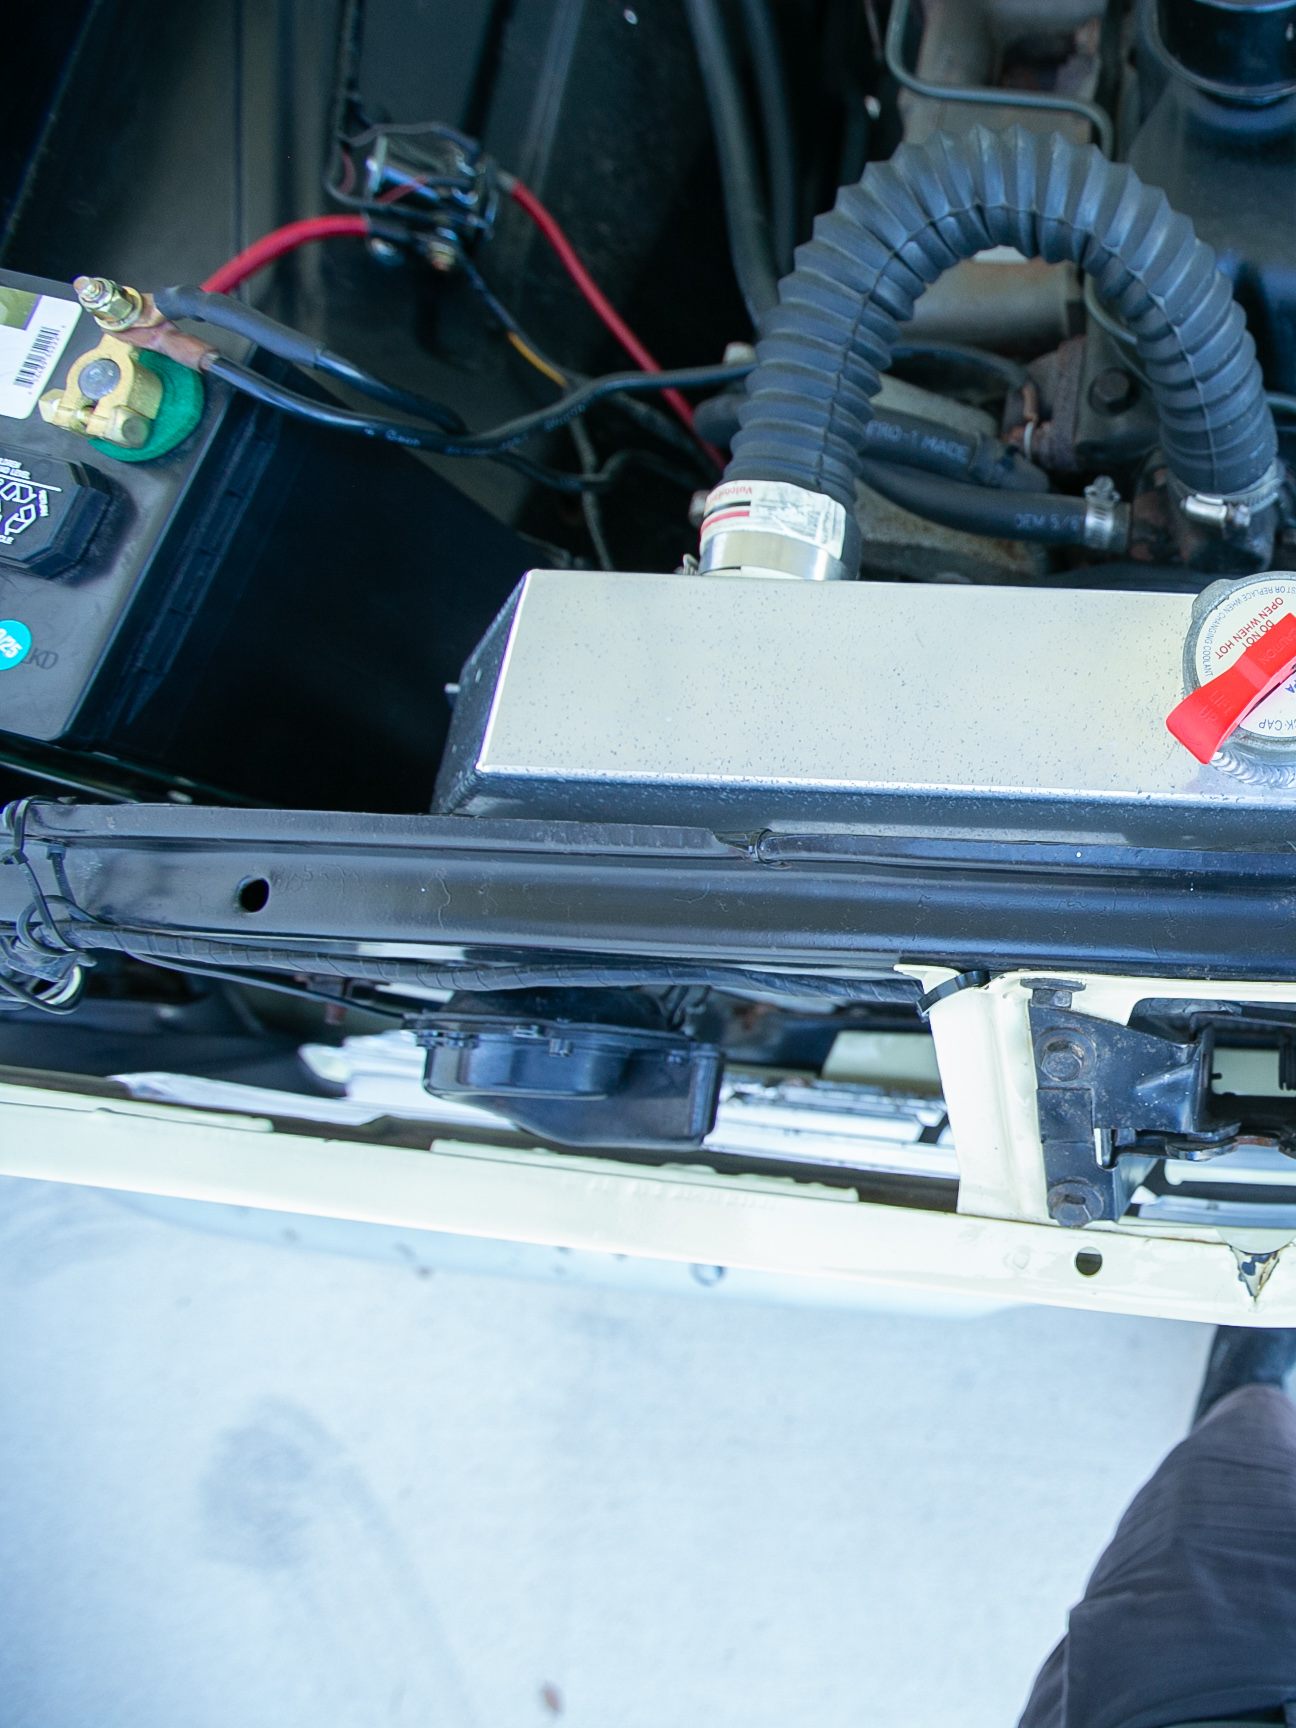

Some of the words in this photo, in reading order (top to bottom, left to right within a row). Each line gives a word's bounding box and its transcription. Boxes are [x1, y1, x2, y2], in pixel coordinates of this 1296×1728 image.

[1241, 586, 1274, 602] REPLACE
[1274, 585, 1286, 594] OR
[1223, 597, 1243, 614] WHEN
[1258, 597, 1284, 620] OPEN
[1204, 612, 1226, 645] CHANGING
[1232, 617, 1261, 643] WHEN
[1259, 619, 1275, 633] DO
[1241, 631, 1262, 648] NOT
[1215, 640, 1235, 660] HOT
[1202, 645, 1214, 677] COOLANT
[1258, 718, 1283, 731] CAP
